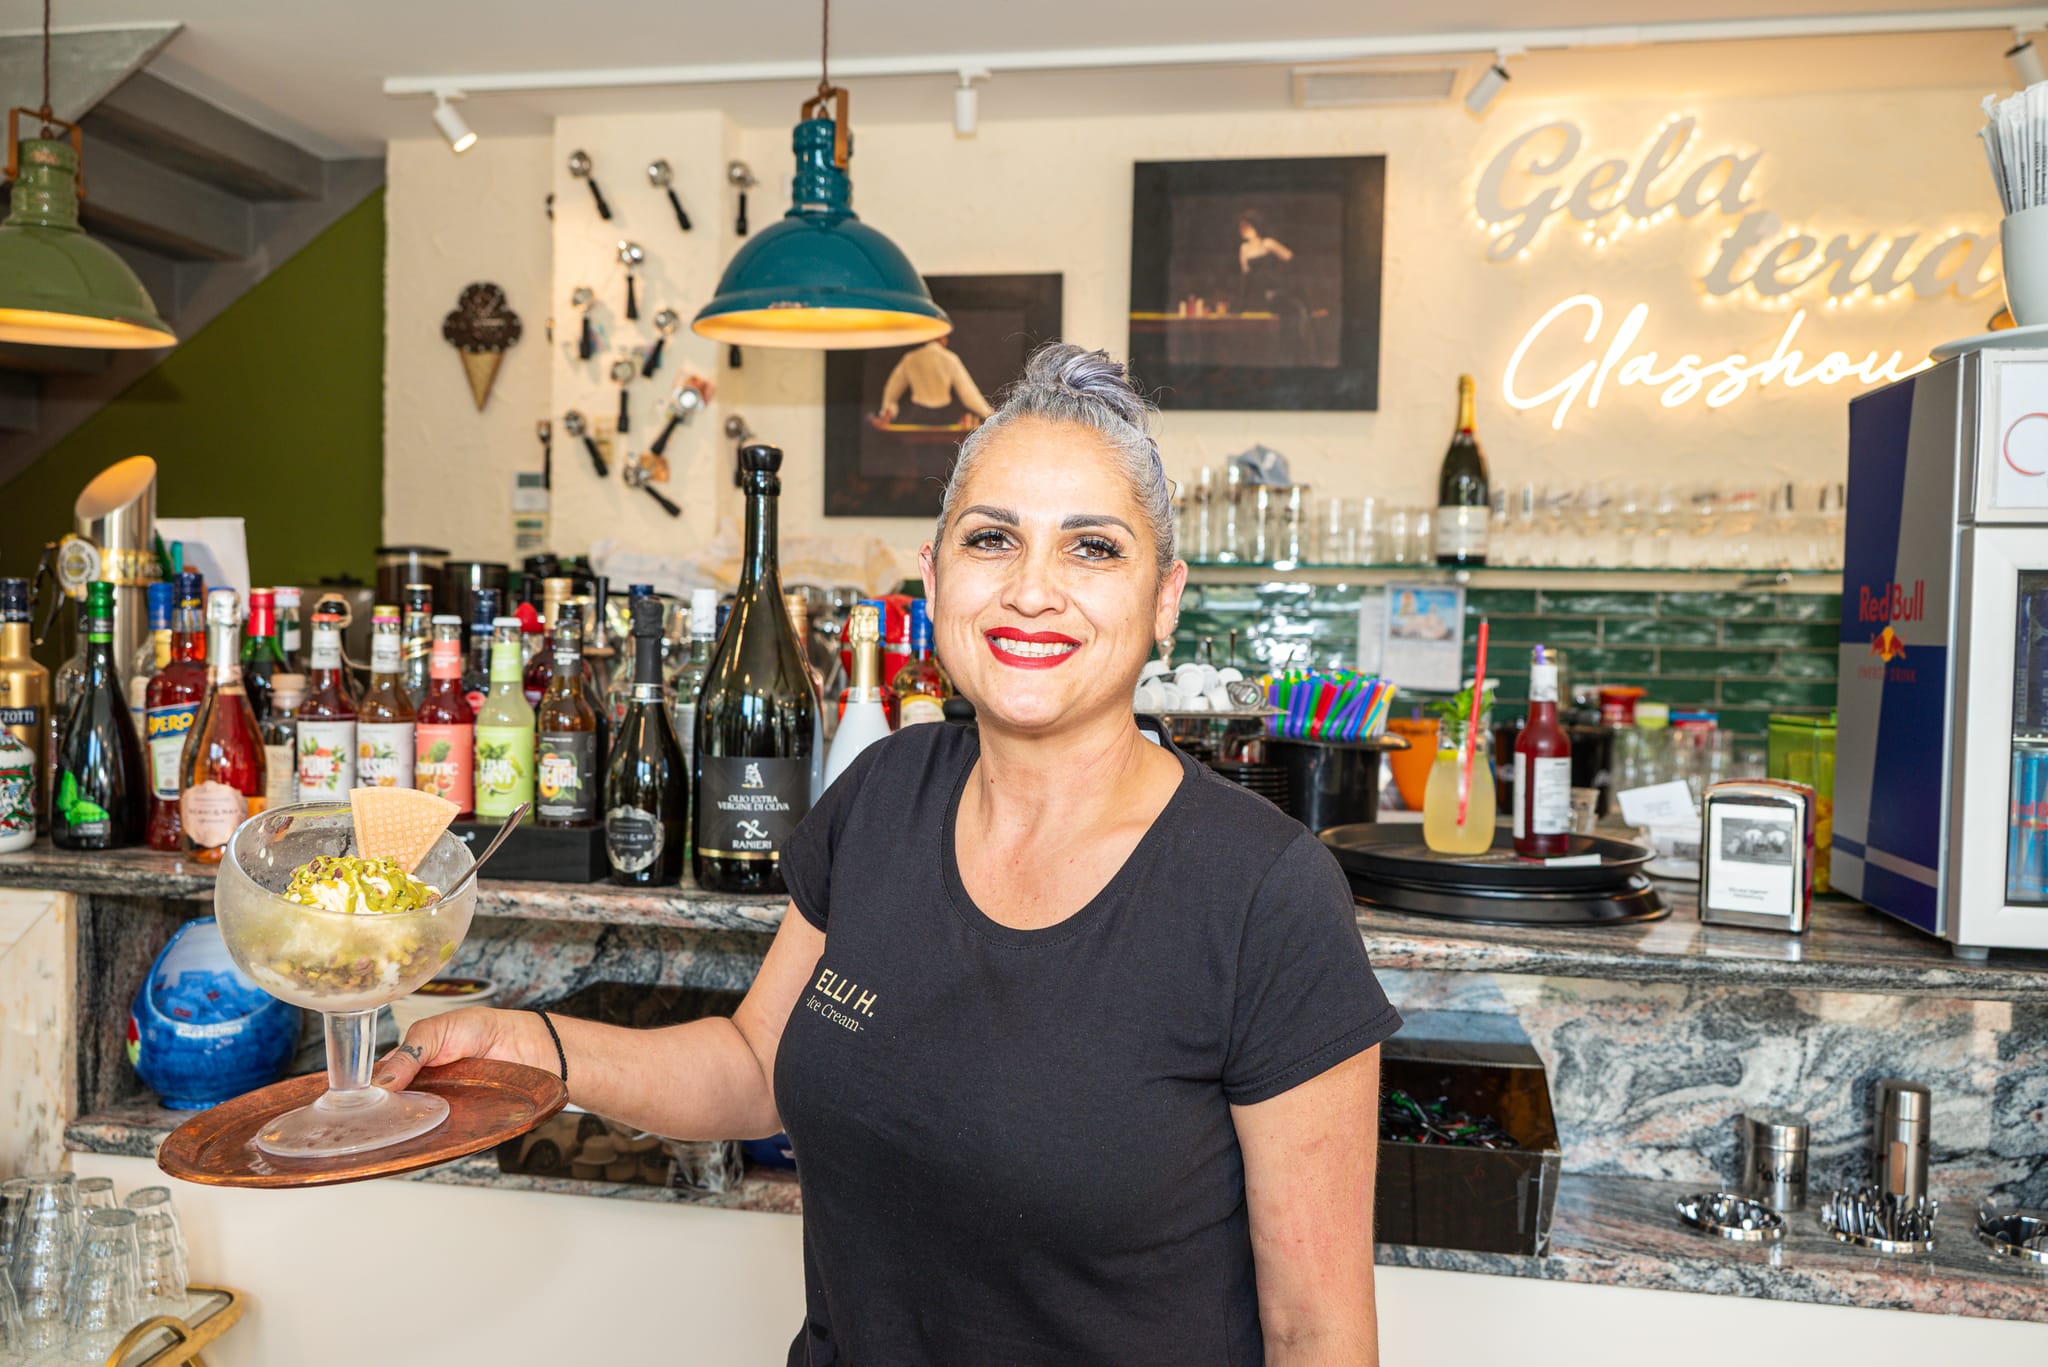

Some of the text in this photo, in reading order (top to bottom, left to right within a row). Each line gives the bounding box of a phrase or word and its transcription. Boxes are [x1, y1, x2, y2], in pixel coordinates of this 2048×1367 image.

[1474, 116, 1763, 262] Gela
[1503, 294, 1936, 430] Glasshou
[1859, 580, 1925, 622] Red Bull
[149, 711, 194, 735] PERO
[717, 801, 790, 811] VERGINE DI OLIVA
[728, 795, 779, 803] OLIO EXTRA
[732, 840, 772, 849] RANIERI
[815, 968, 877, 1018] ELLI H.
